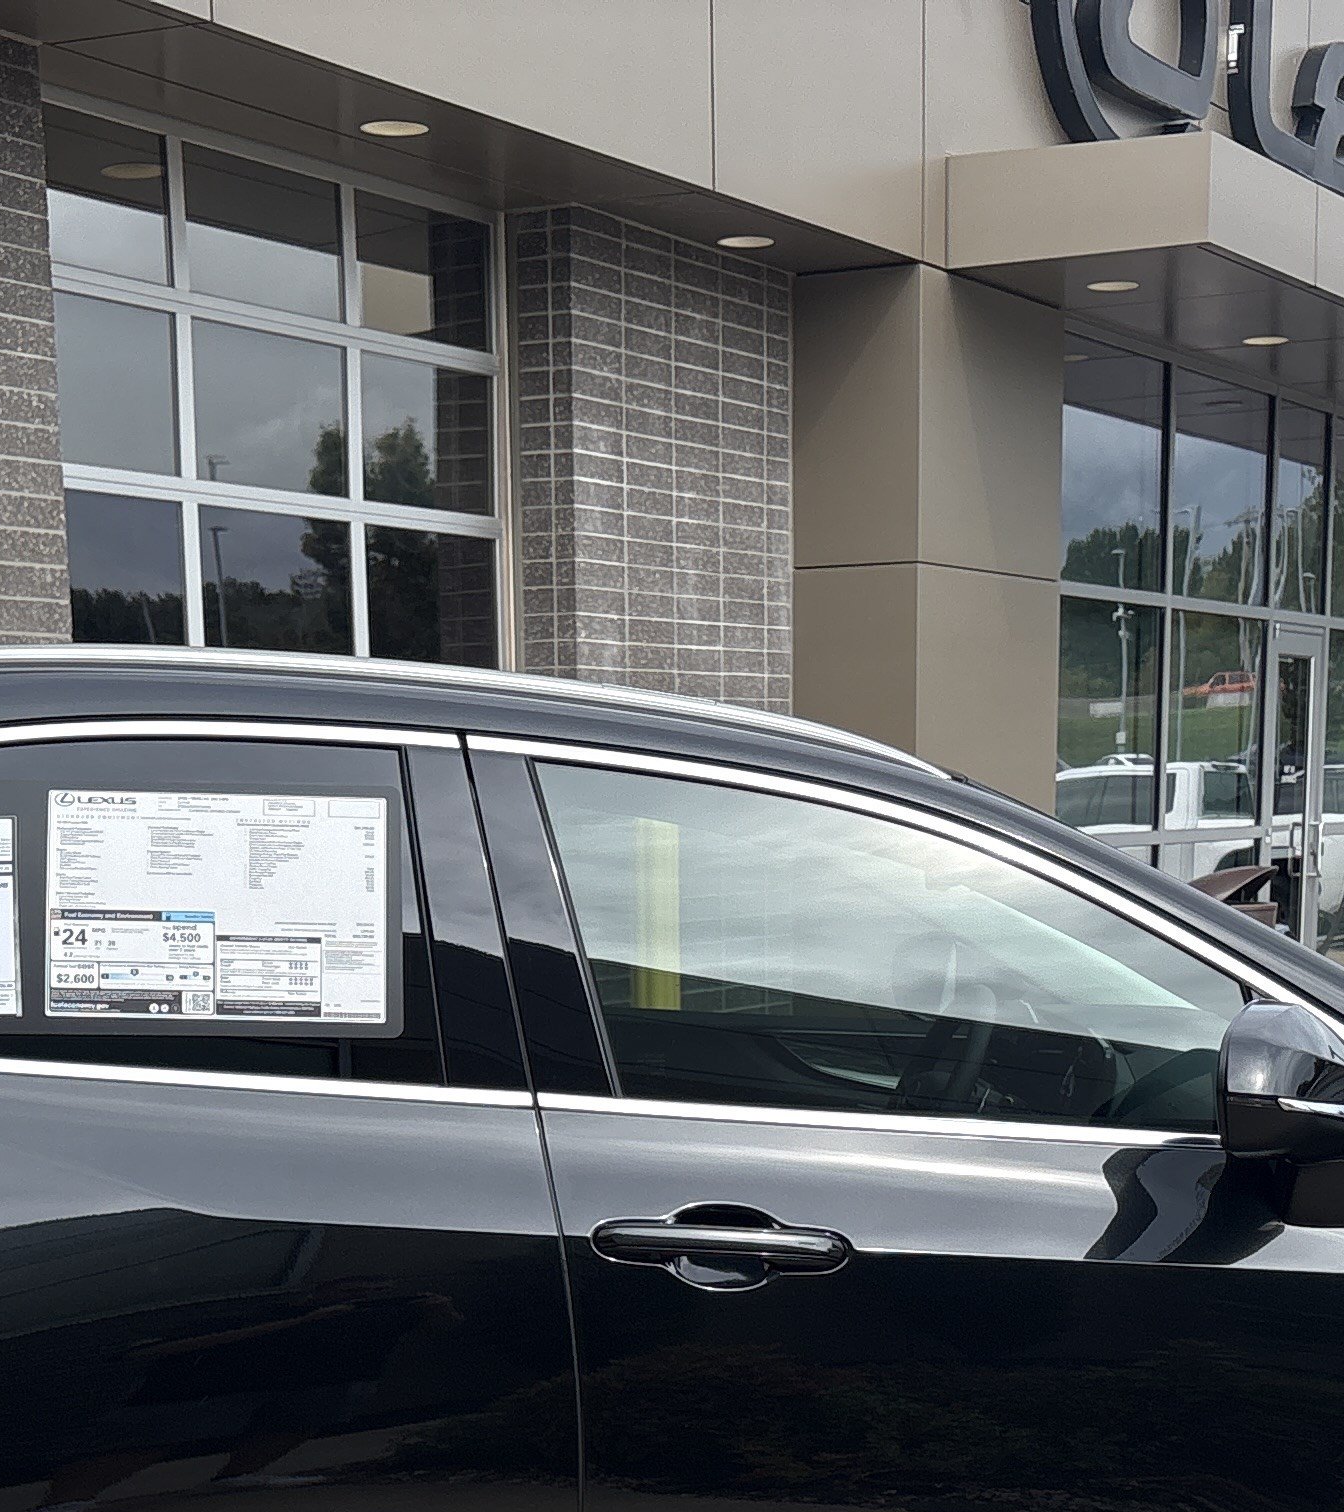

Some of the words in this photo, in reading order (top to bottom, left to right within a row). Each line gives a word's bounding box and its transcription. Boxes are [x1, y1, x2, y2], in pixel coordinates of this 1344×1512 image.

[77, 796, 137, 804] LEXUS
[62, 928, 88, 946] 24
[162, 932, 202, 943] $4,500
[56, 972, 95, 984] $2,600
